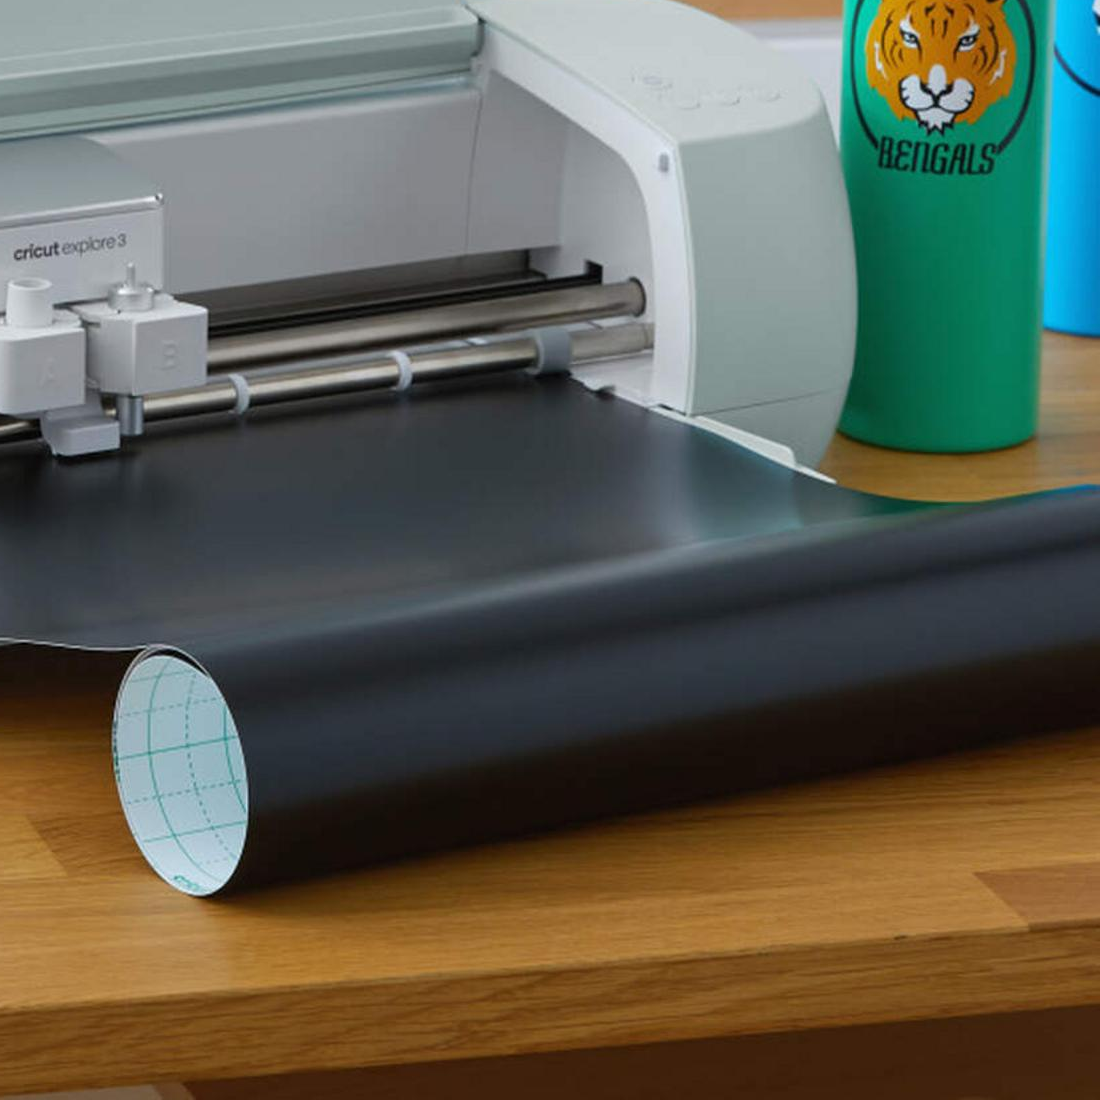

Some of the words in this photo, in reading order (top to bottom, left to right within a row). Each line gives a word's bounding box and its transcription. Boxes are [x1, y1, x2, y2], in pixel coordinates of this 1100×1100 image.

[877, 136, 998, 175] BENGALS
[13, 242, 59, 261] cricut
[61, 235, 116, 259] explore
[117, 233, 127, 248] 3
